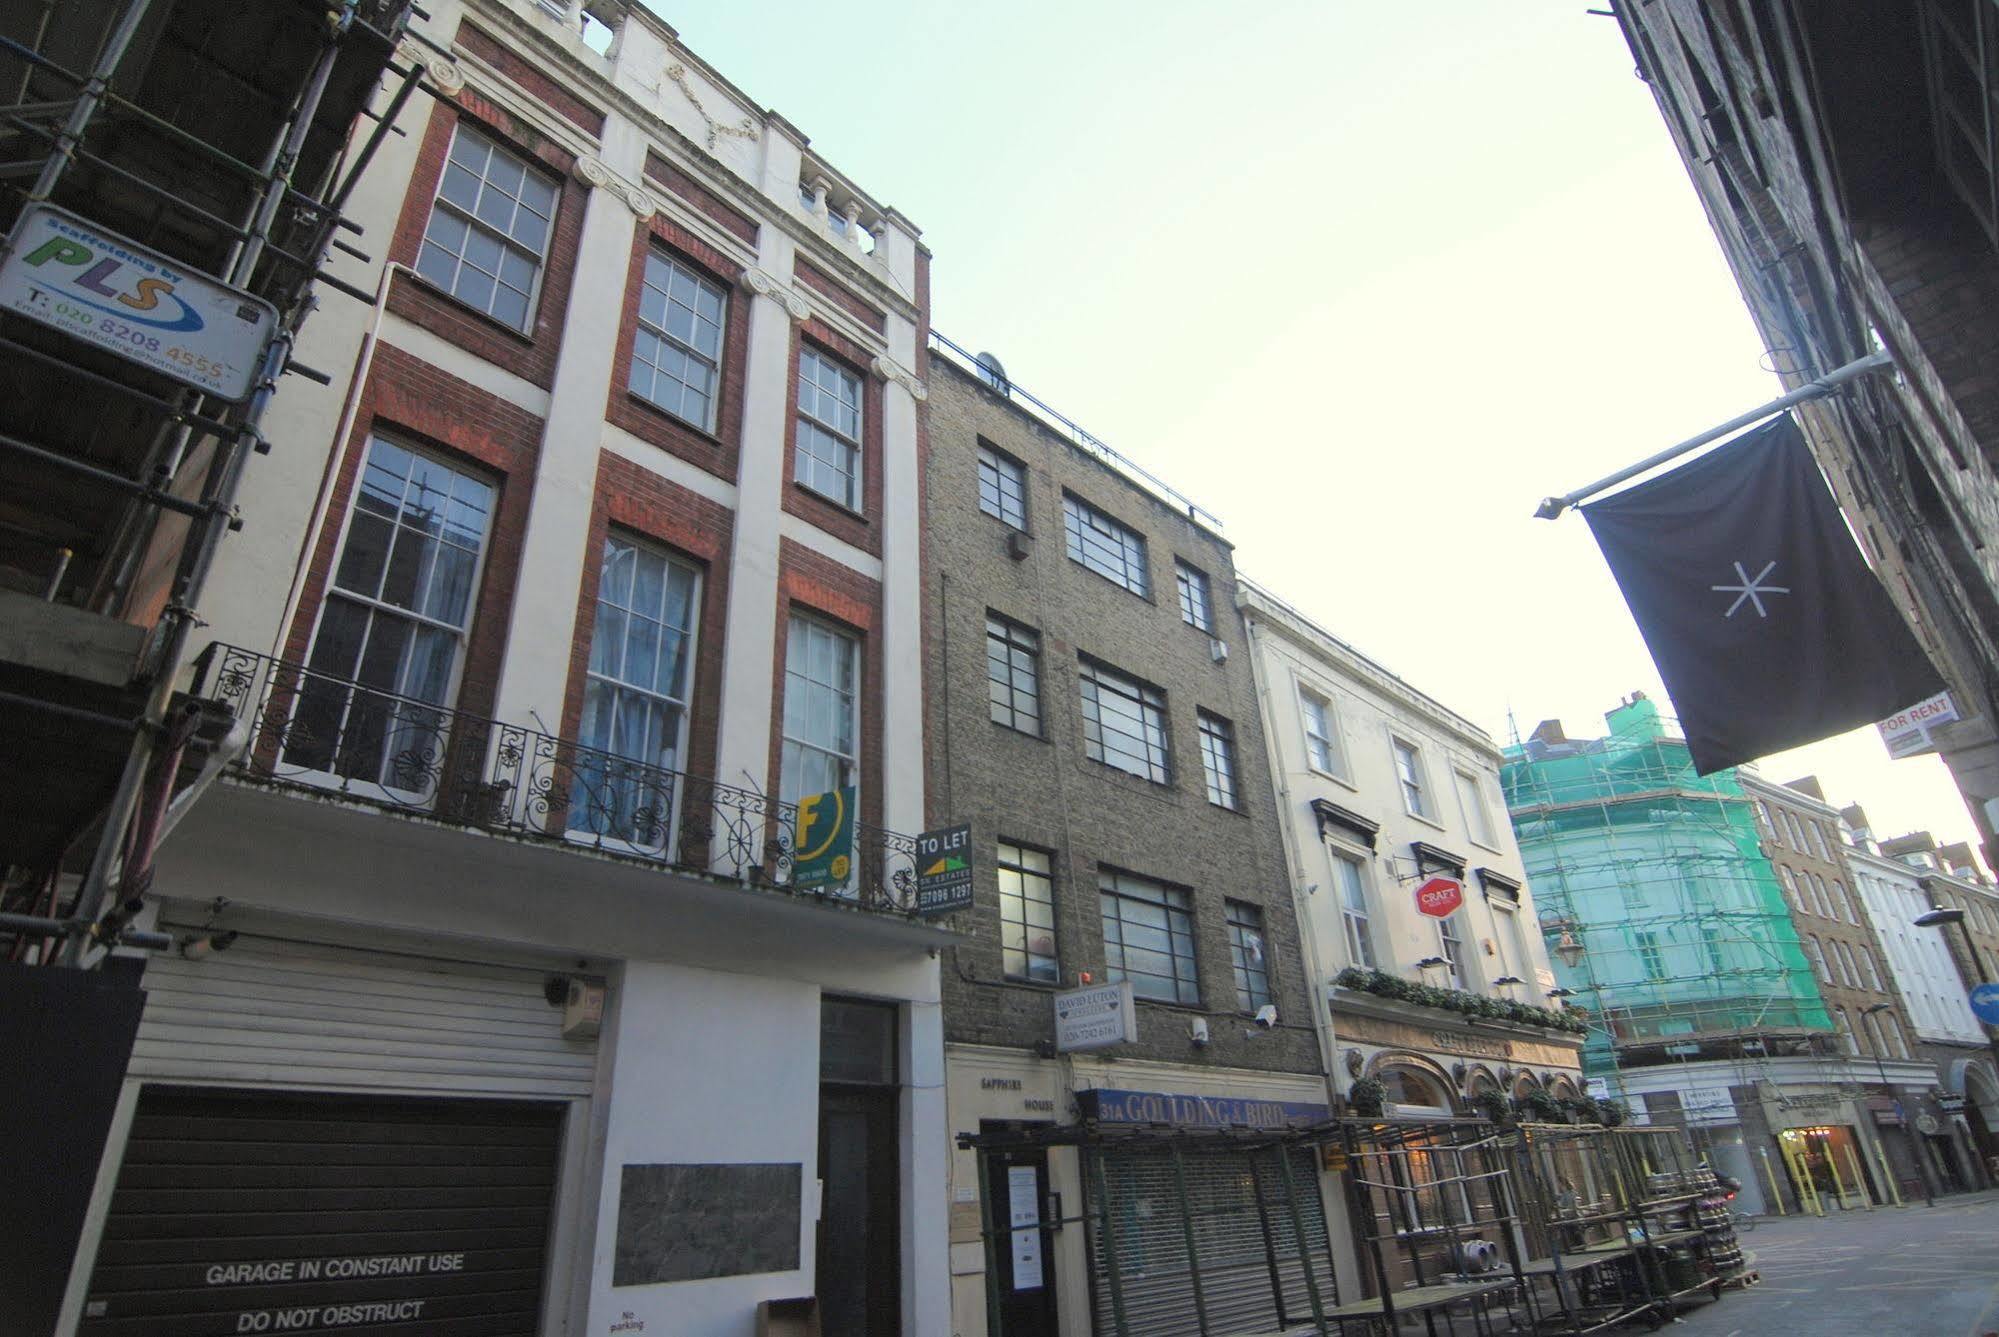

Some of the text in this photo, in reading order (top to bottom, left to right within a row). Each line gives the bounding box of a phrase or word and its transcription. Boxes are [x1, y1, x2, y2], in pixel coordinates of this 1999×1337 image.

[46, 217, 184, 284] Scaffolding by
[22, 235, 175, 311] PLS
[28, 286, 224, 379] T: 020 8208 4555
[1880, 699, 1948, 734] FOR RENT
[920, 830, 968, 855] TO LET
[1421, 888, 1457, 903] CRAFT
[1024, 1098, 1054, 1112] HOUSE
[206, 1254, 465, 1284] GARAGE IN CONSTANT USE
[237, 1301, 425, 1332] DO NOT OBSTRUCT
[609, 1321, 645, 1333] parking
[622, 1311, 635, 1320] No
